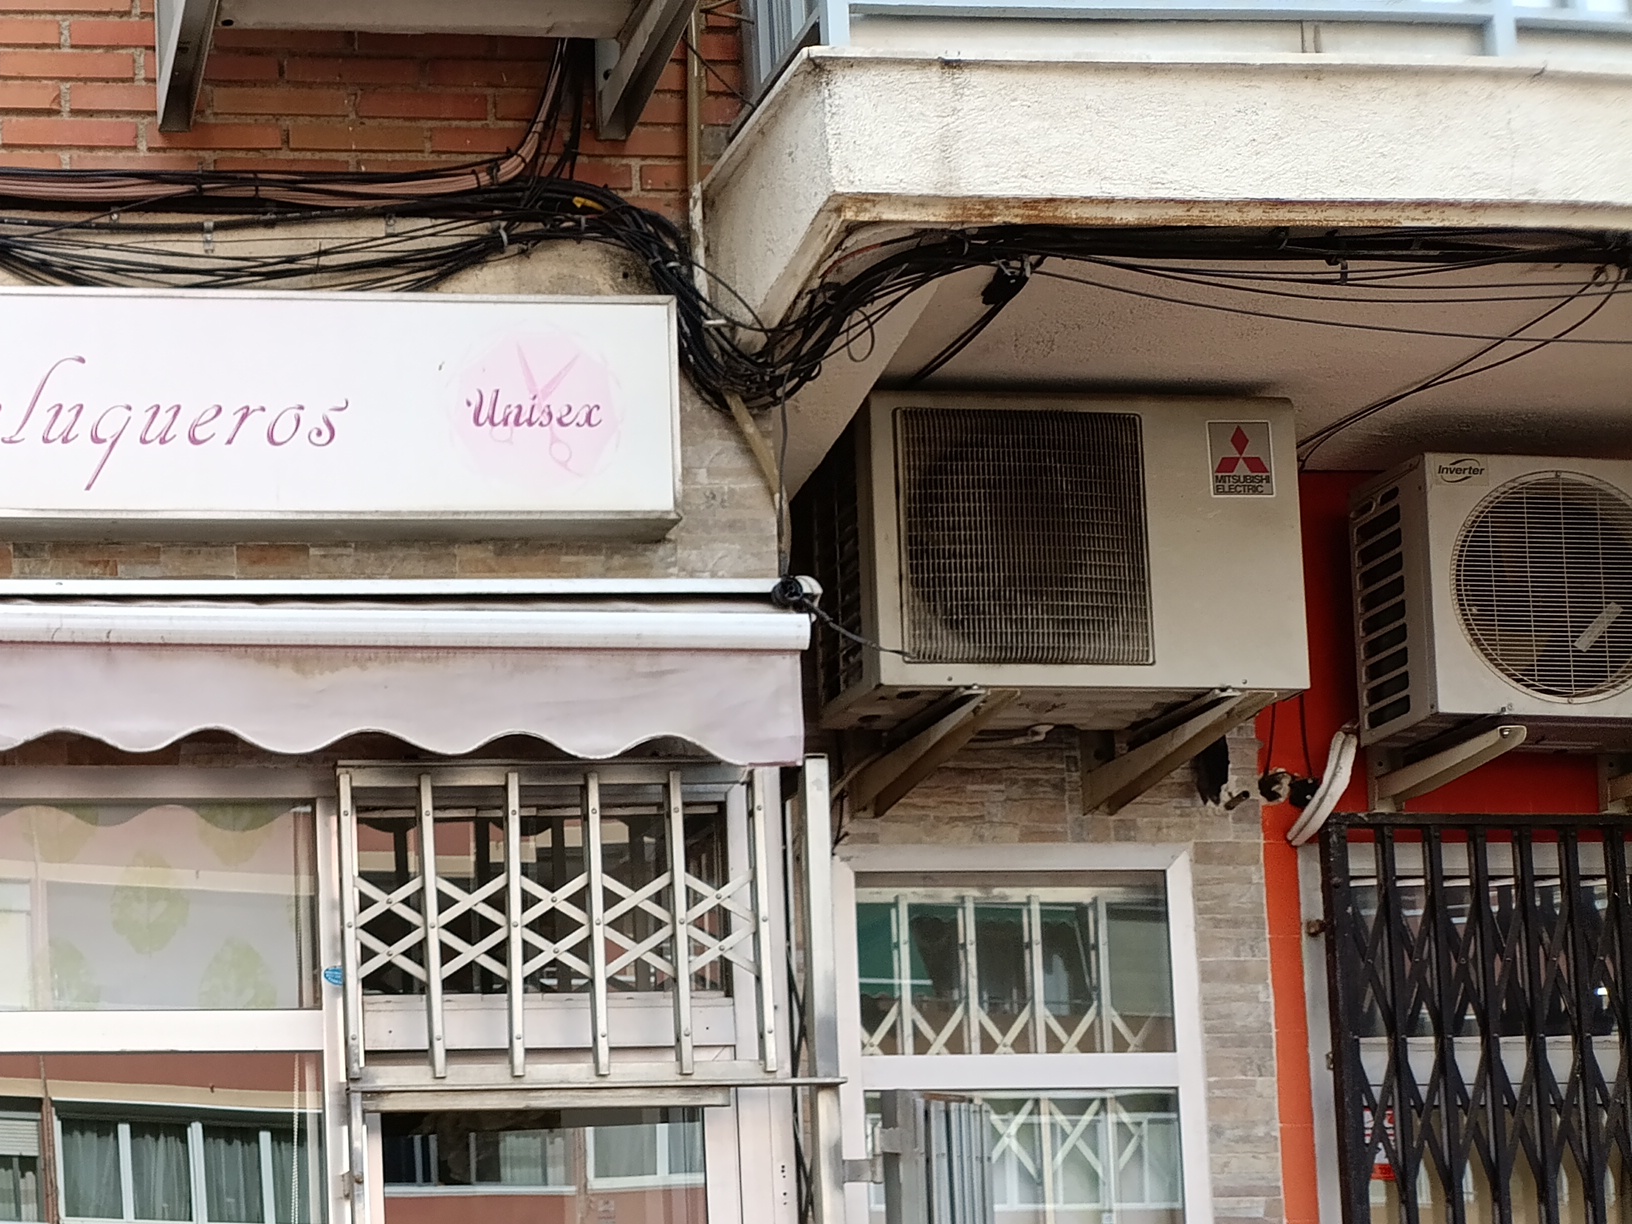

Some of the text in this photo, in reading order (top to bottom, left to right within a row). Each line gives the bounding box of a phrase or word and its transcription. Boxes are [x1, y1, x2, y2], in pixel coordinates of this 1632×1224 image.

[465, 388, 603, 429] Unisex
[1437, 464, 1486, 476] Inverter
[1214, 474, 1270, 484] MITSUBISHI
[1215, 484, 1264, 494] ELECTRIC
